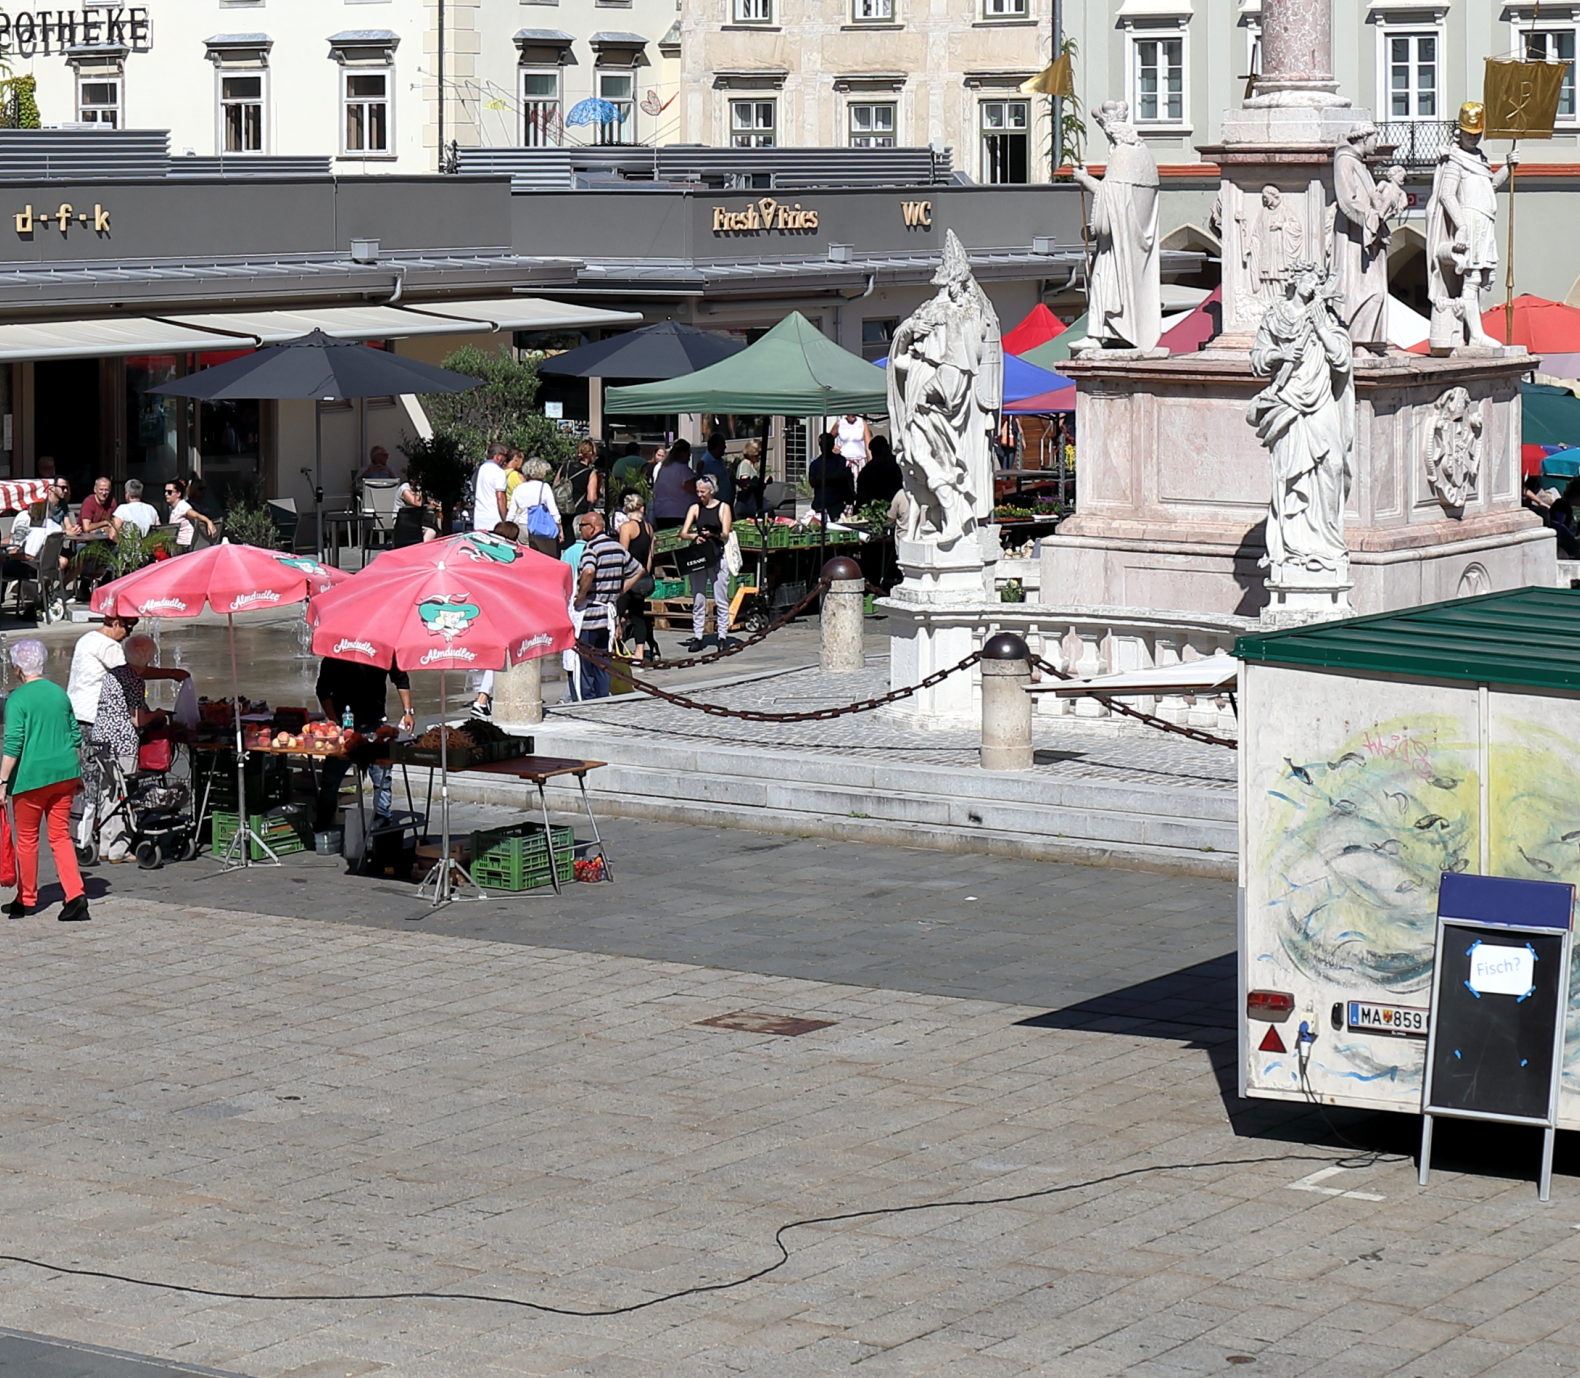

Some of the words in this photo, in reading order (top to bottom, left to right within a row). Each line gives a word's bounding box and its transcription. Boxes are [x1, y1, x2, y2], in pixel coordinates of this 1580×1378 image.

[712, 204, 761, 231] Fresh
[777, 203, 819, 230] Fries
[900, 201, 933, 227] WC
[138, 597, 187, 613] Almdudler
[230, 589, 281, 610] Almdudler
[334, 638, 377, 658] Almdudler
[517, 632, 554, 658] Almdudler
[420, 646, 478, 665] Almdudler
[1477, 957, 1521, 977] Fisch?
[1361, 1007, 1382, 1025] MA
